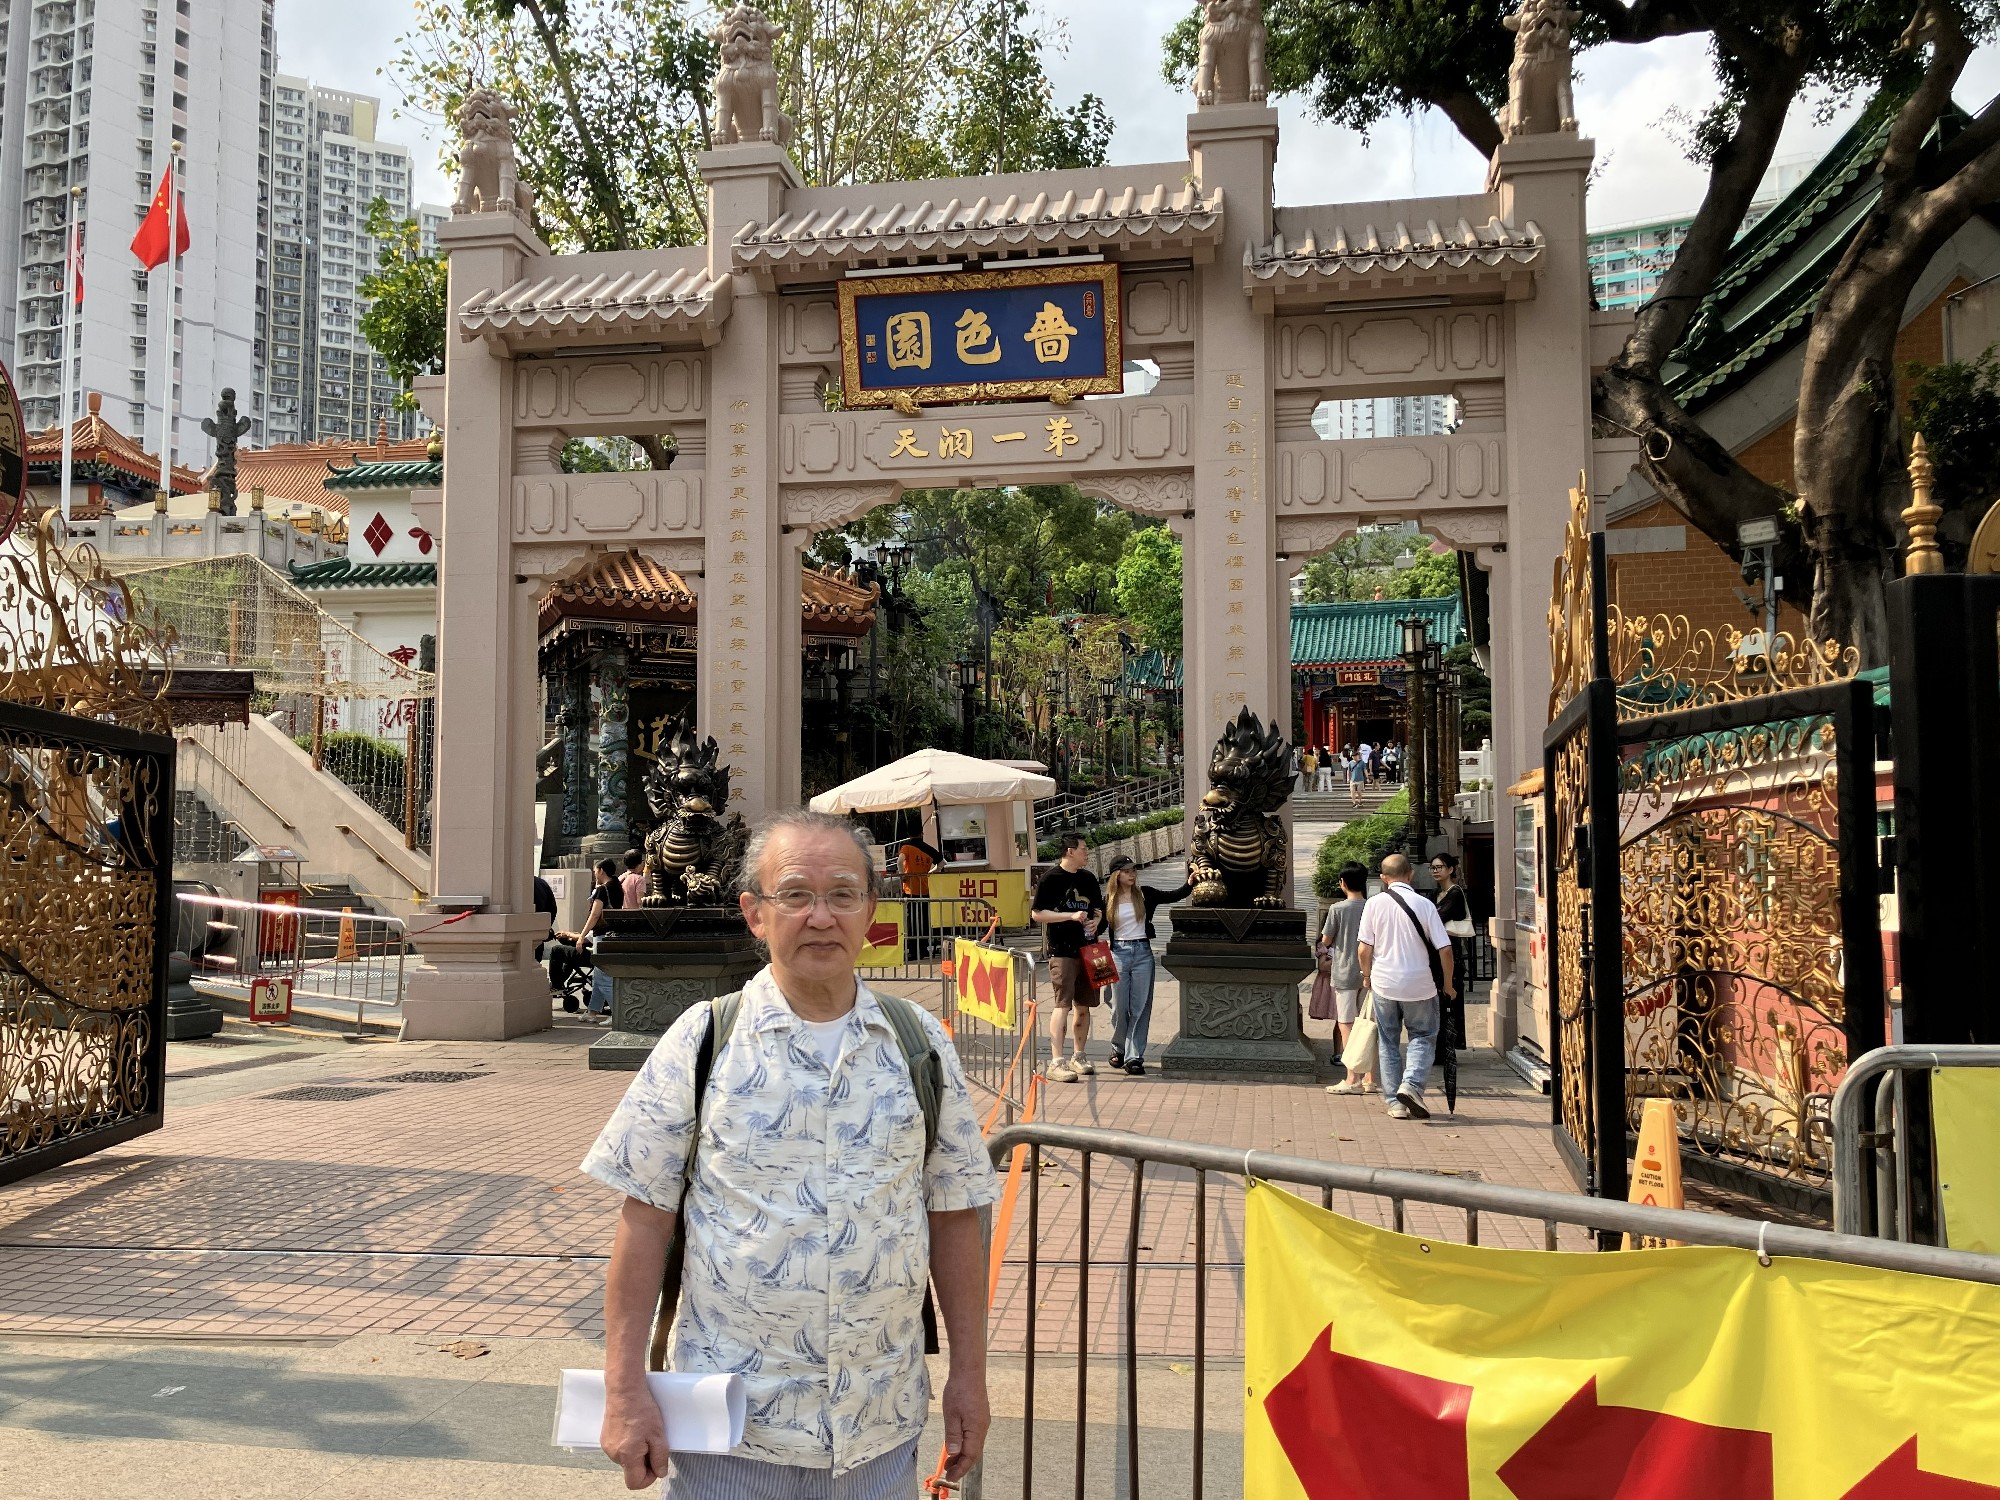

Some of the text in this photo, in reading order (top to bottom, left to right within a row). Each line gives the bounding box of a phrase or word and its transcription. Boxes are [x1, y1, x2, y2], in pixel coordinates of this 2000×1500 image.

[886, 301, 1078, 370] 嗇色園
[958, 877, 998, 899] 出口
[960, 905, 998, 925] Exit
[1640, 1172, 1661, 1181] CAUTION
[1648, 1180, 1665, 1188] FLOOR
